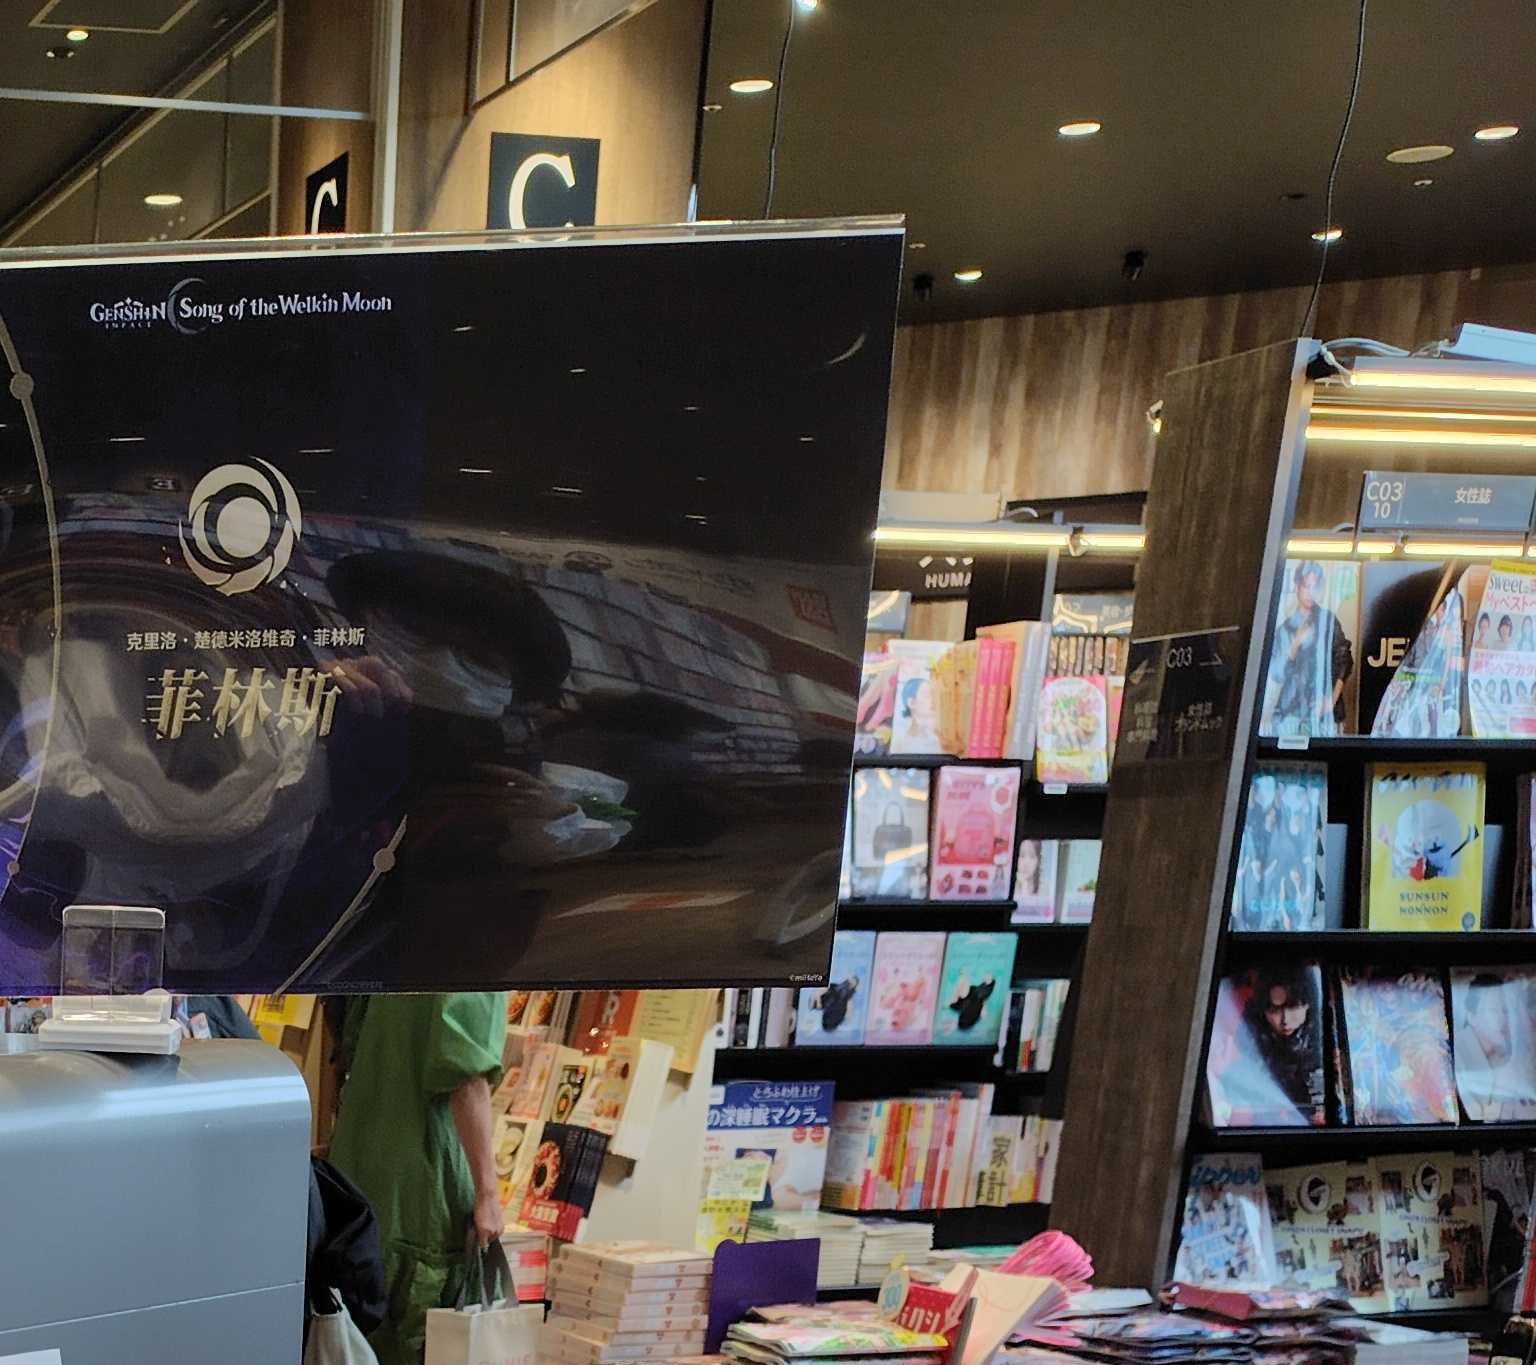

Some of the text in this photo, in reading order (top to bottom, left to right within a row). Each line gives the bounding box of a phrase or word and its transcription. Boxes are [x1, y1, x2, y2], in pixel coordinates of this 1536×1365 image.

[180, 297, 222, 323] Song
[229, 298, 248, 320] of
[250, 298, 278, 316] the
[278, 293, 338, 316] Welkin
[342, 292, 392, 313] Moon
[1366, 481, 1403, 501] C03
[1373, 502, 1391, 519] 10
[1166, 646, 1192, 668] C03
[141, 666, 344, 741] 菲林斯
